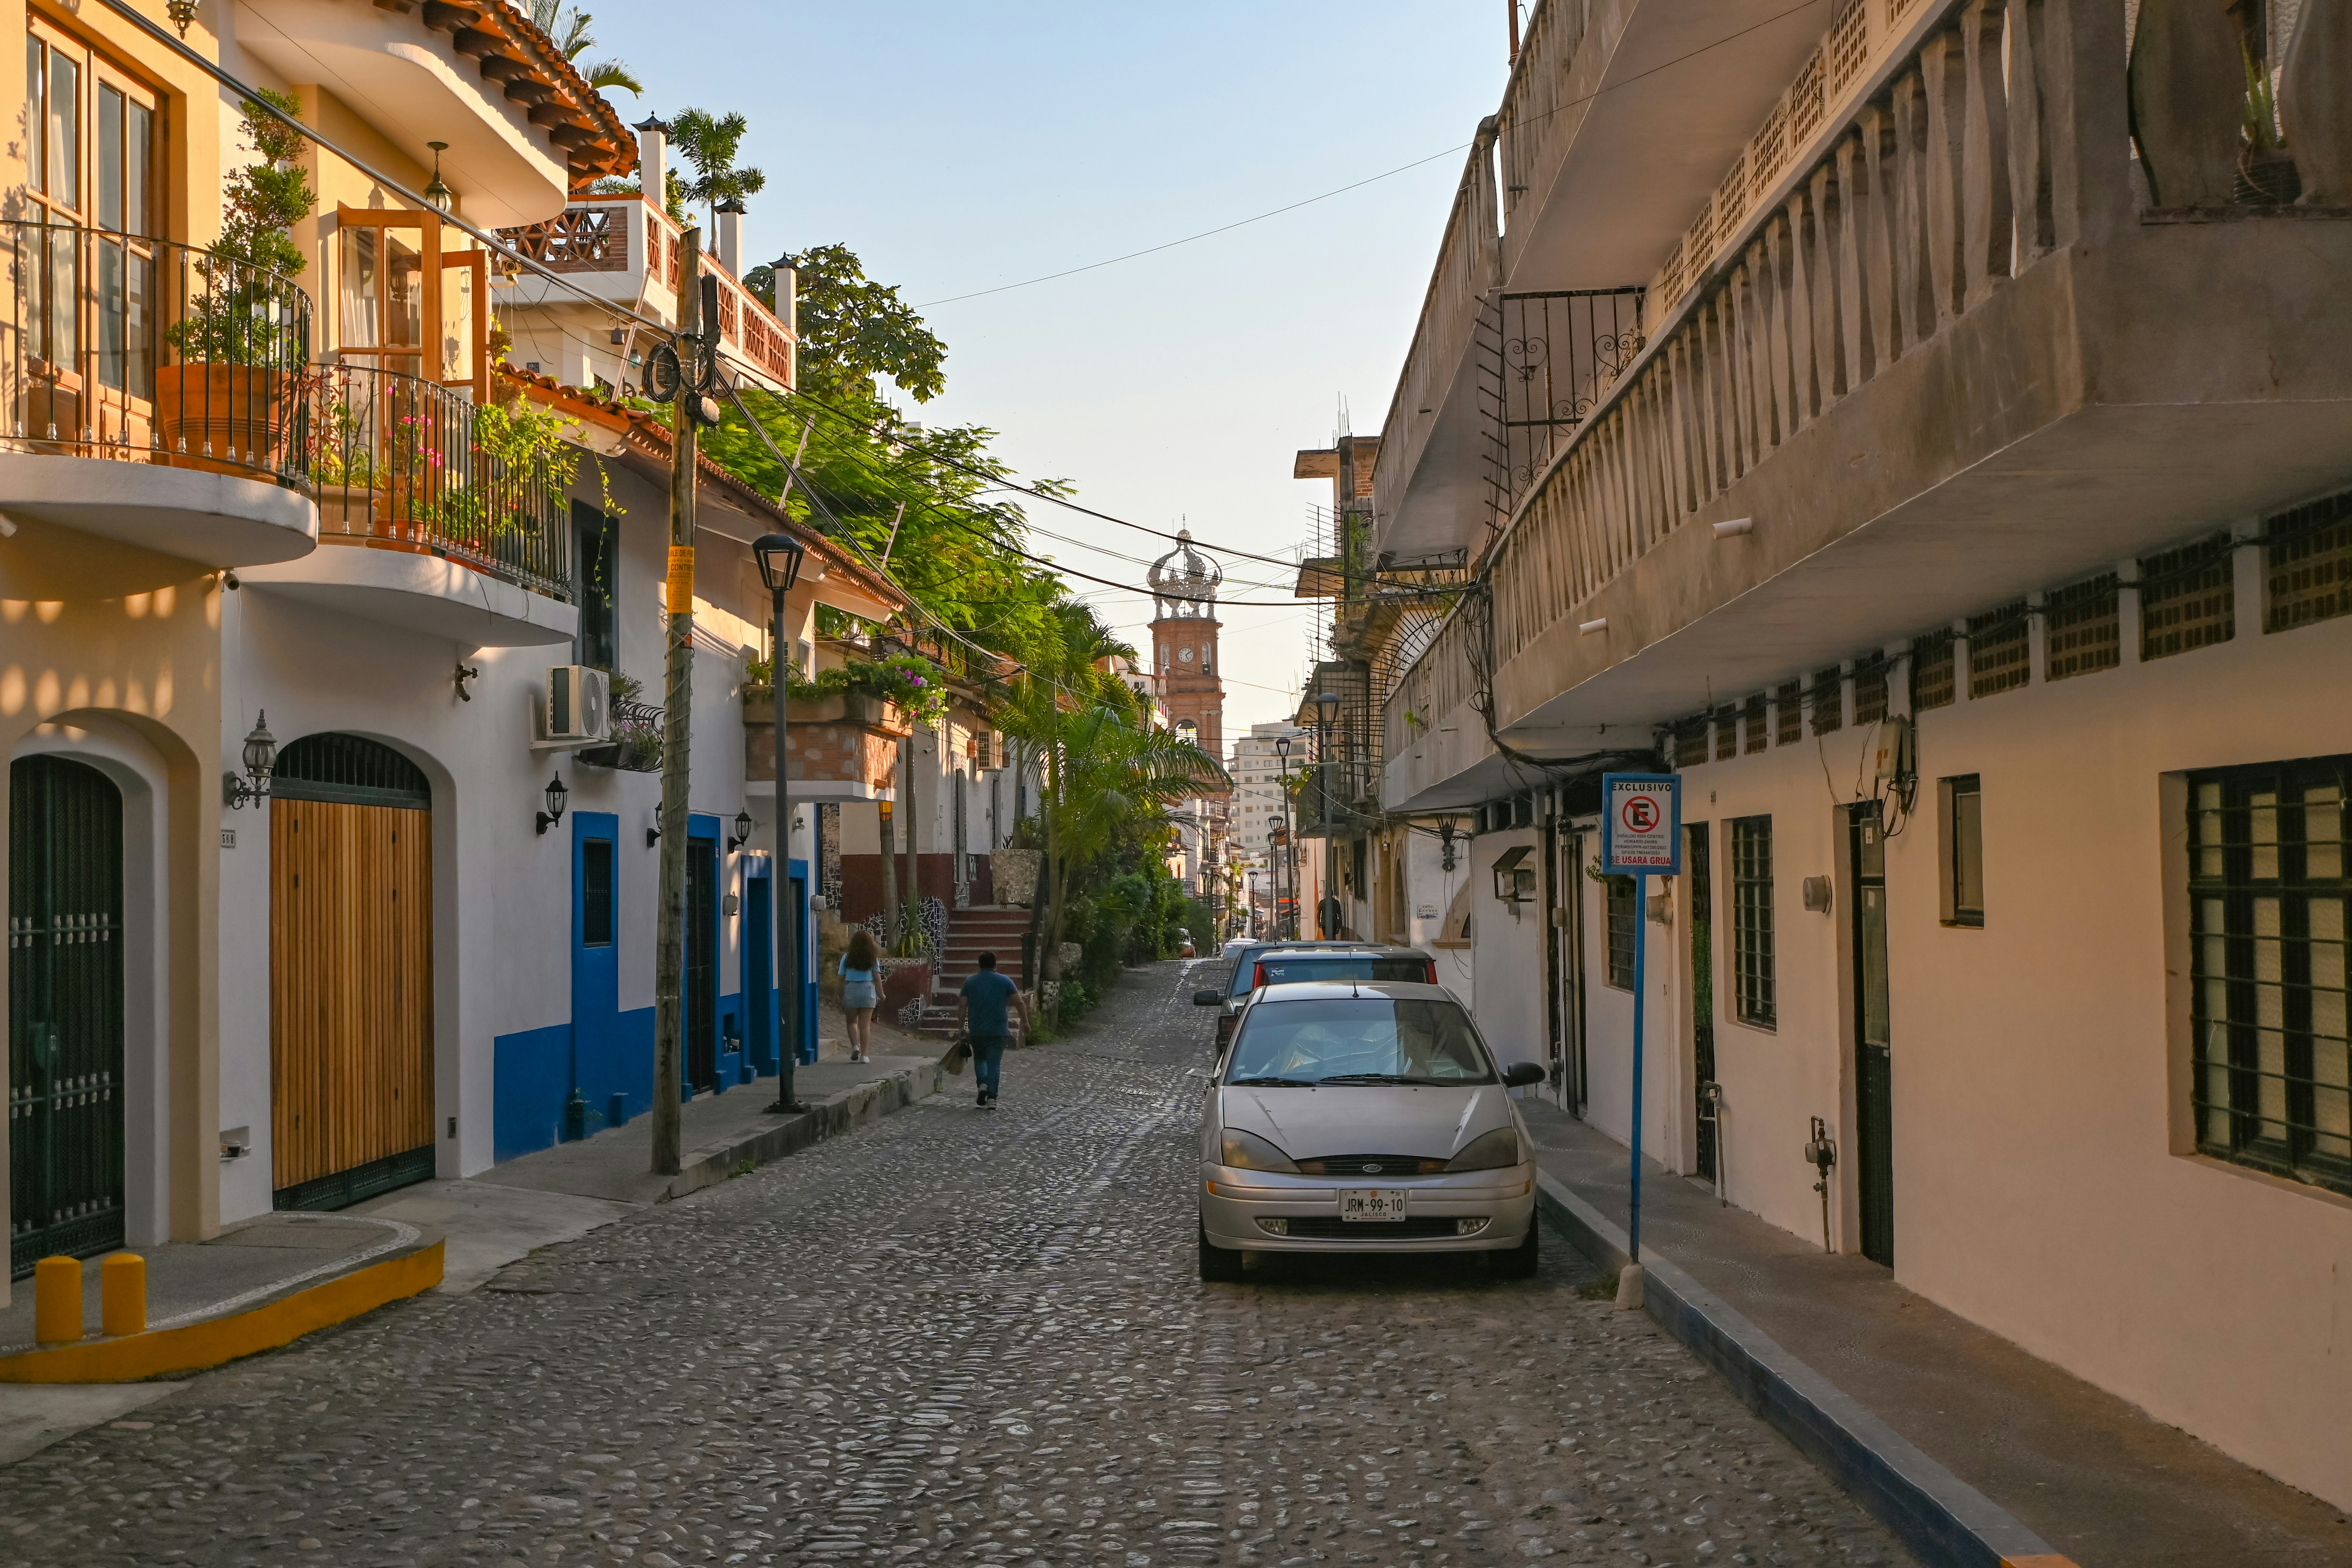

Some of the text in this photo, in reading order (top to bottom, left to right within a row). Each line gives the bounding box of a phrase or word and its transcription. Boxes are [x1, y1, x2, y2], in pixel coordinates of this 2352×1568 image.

[1612, 783, 1671, 792] EXCLUSIVO
[1633, 803, 1649, 826] E
[222, 834, 234, 844] 568
[1612, 855, 1671, 865] SE USARA GRUA
[1345, 1198, 1403, 1212] JRM-99-10
